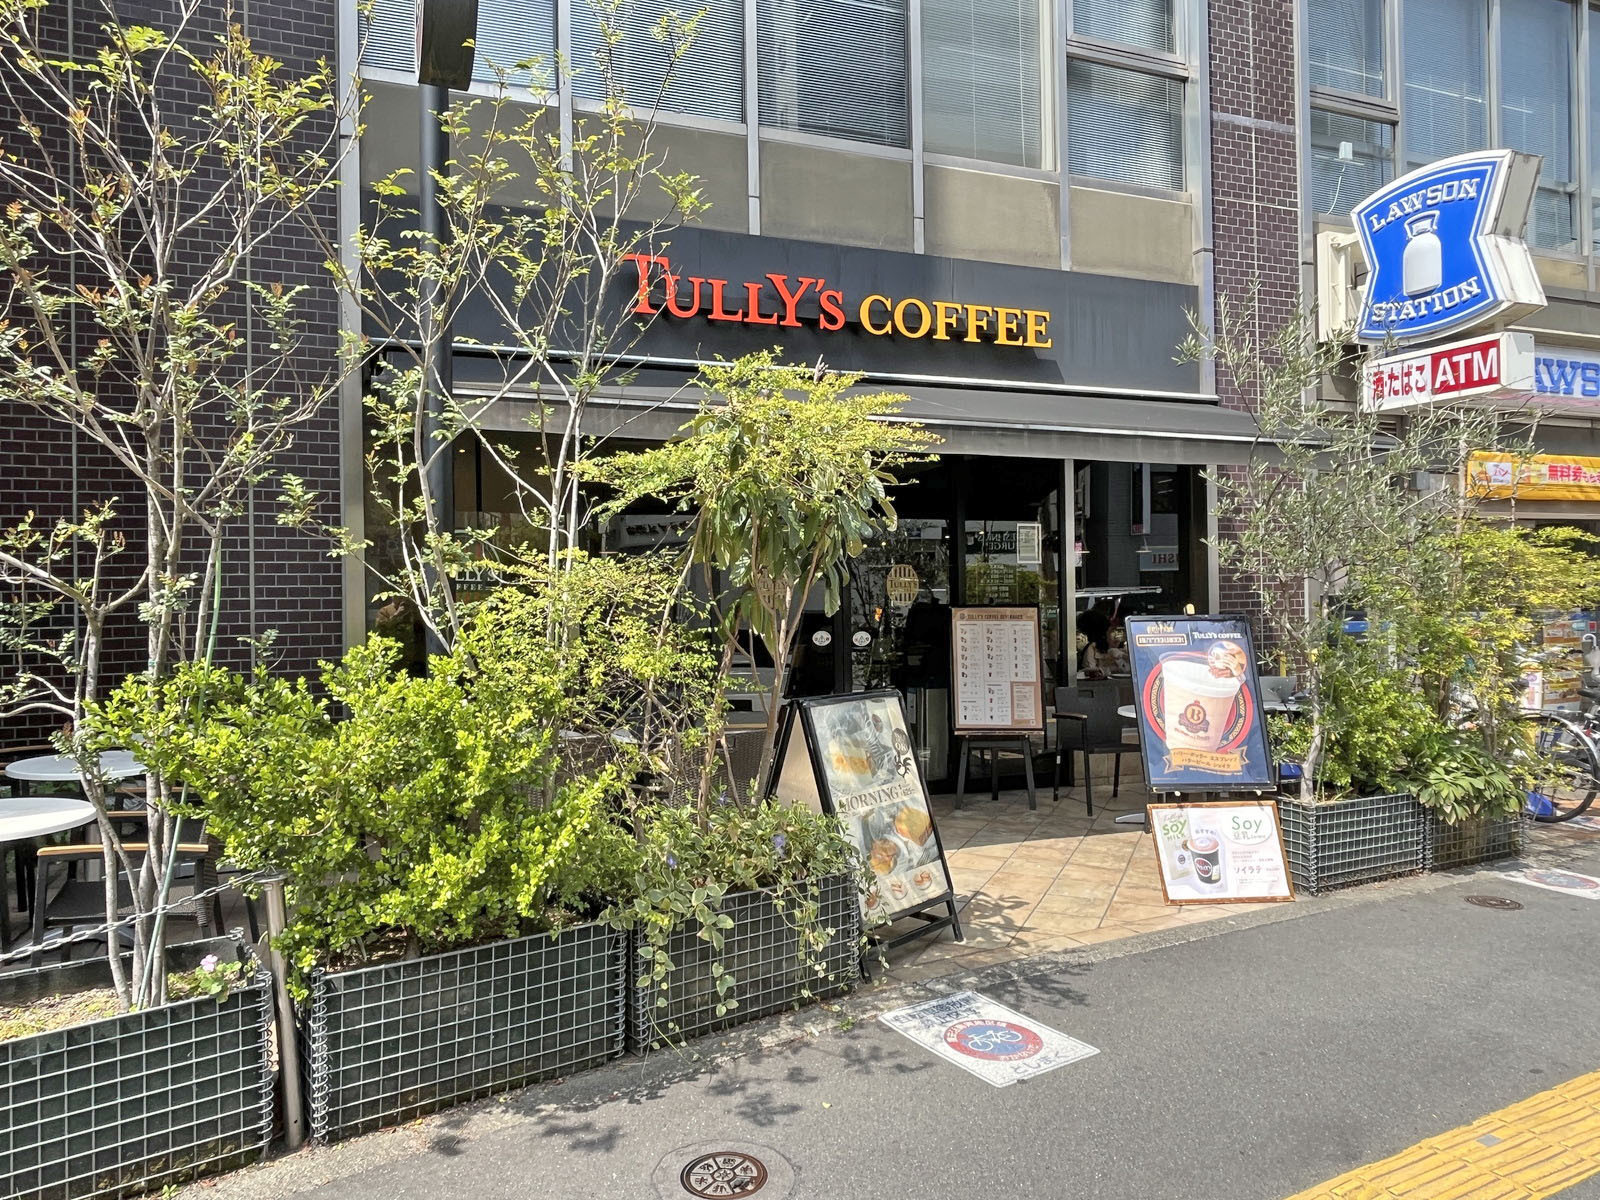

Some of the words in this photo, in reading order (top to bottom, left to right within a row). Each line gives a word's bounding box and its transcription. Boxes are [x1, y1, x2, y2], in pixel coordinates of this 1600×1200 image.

[1369, 177, 1481, 233] LAWSON
[622, 253, 847, 331] TULLY'S
[859, 294, 1052, 348] COFFEE
[1371, 276, 1481, 323] STATION
[1434, 347, 1498, 389] ATM
[1162, 819, 1187, 836] SOY
[1231, 815, 1262, 833] Soy
